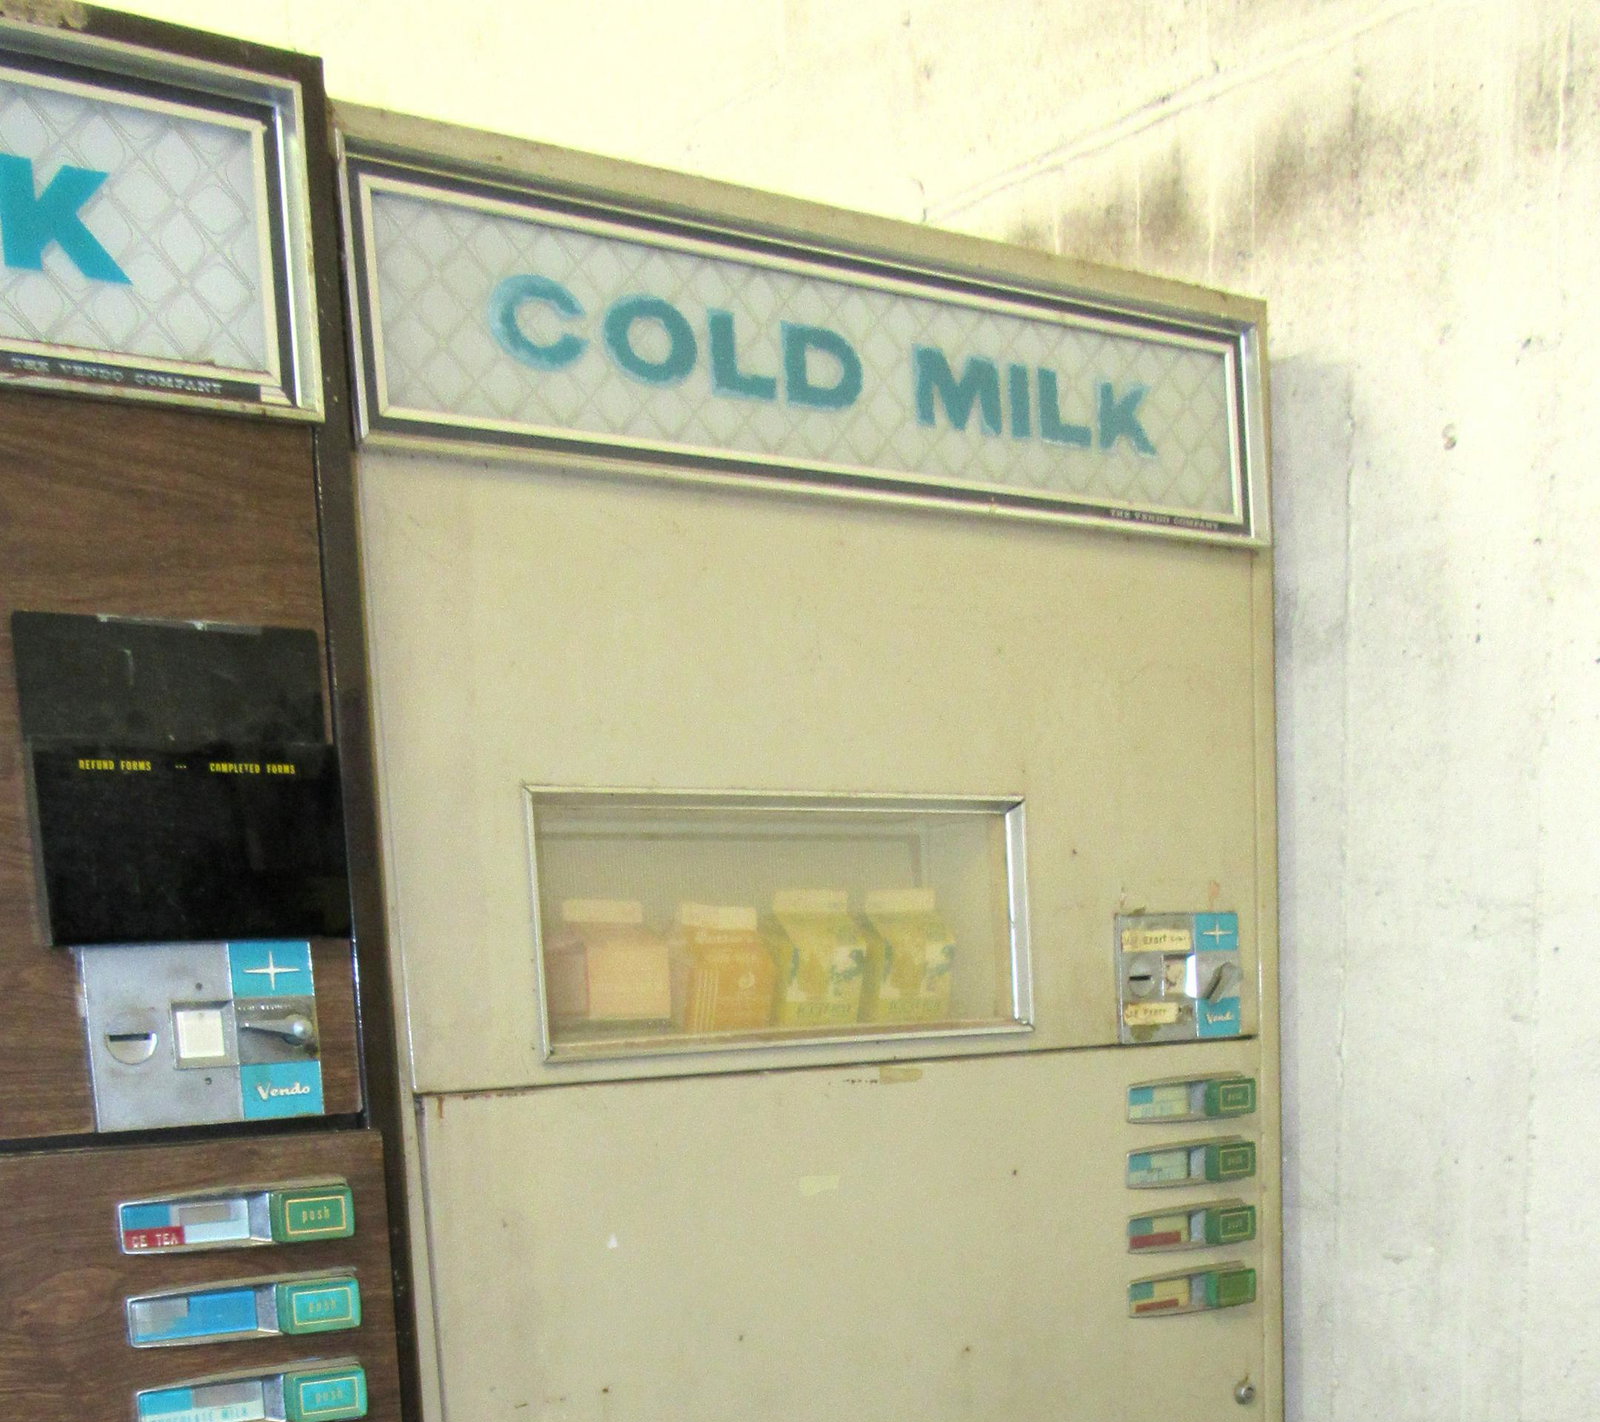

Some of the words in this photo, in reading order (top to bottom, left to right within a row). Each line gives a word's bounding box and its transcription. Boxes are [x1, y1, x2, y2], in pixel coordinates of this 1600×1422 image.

[488, 274, 863, 411] COLD
[911, 343, 1156, 457] MILK
[11, 357, 49, 371] THE
[59, 363, 124, 382] VENDO
[134, 372, 223, 394] COMPANY
[78, 759, 115, 771] REFUND
[120, 760, 152, 771] FORMS
[209, 762, 261, 773] COMPLETED
[266, 763, 296, 774] FORMS
[256, 1081, 311, 1101] Vendo
[302, 1206, 331, 1224] push
[155, 1232, 178, 1246] TEA
